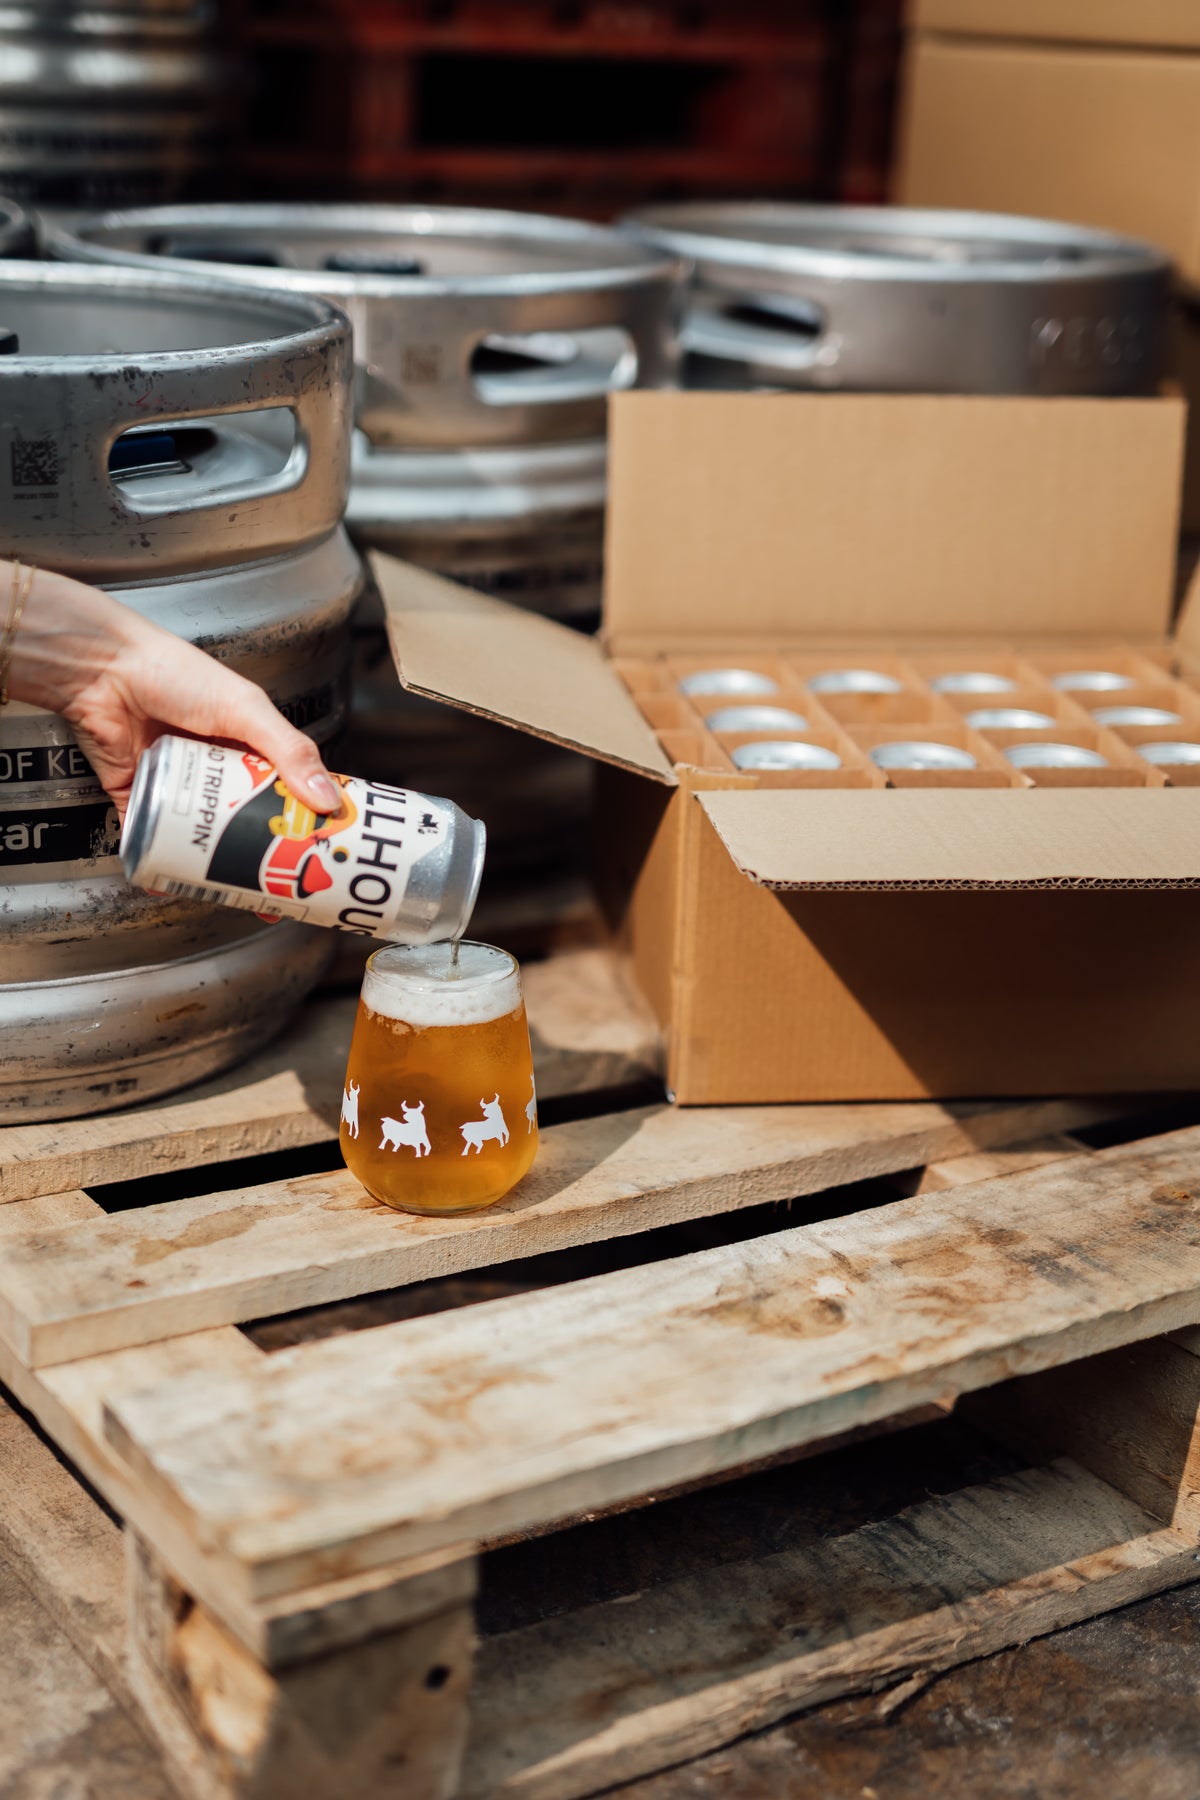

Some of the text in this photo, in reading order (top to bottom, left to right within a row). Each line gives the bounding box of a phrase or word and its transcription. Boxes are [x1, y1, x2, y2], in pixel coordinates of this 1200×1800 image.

[47, 748, 86, 777] KE
[191, 766, 225, 852] TRIPPIN'
[0, 822, 50, 851] ar
